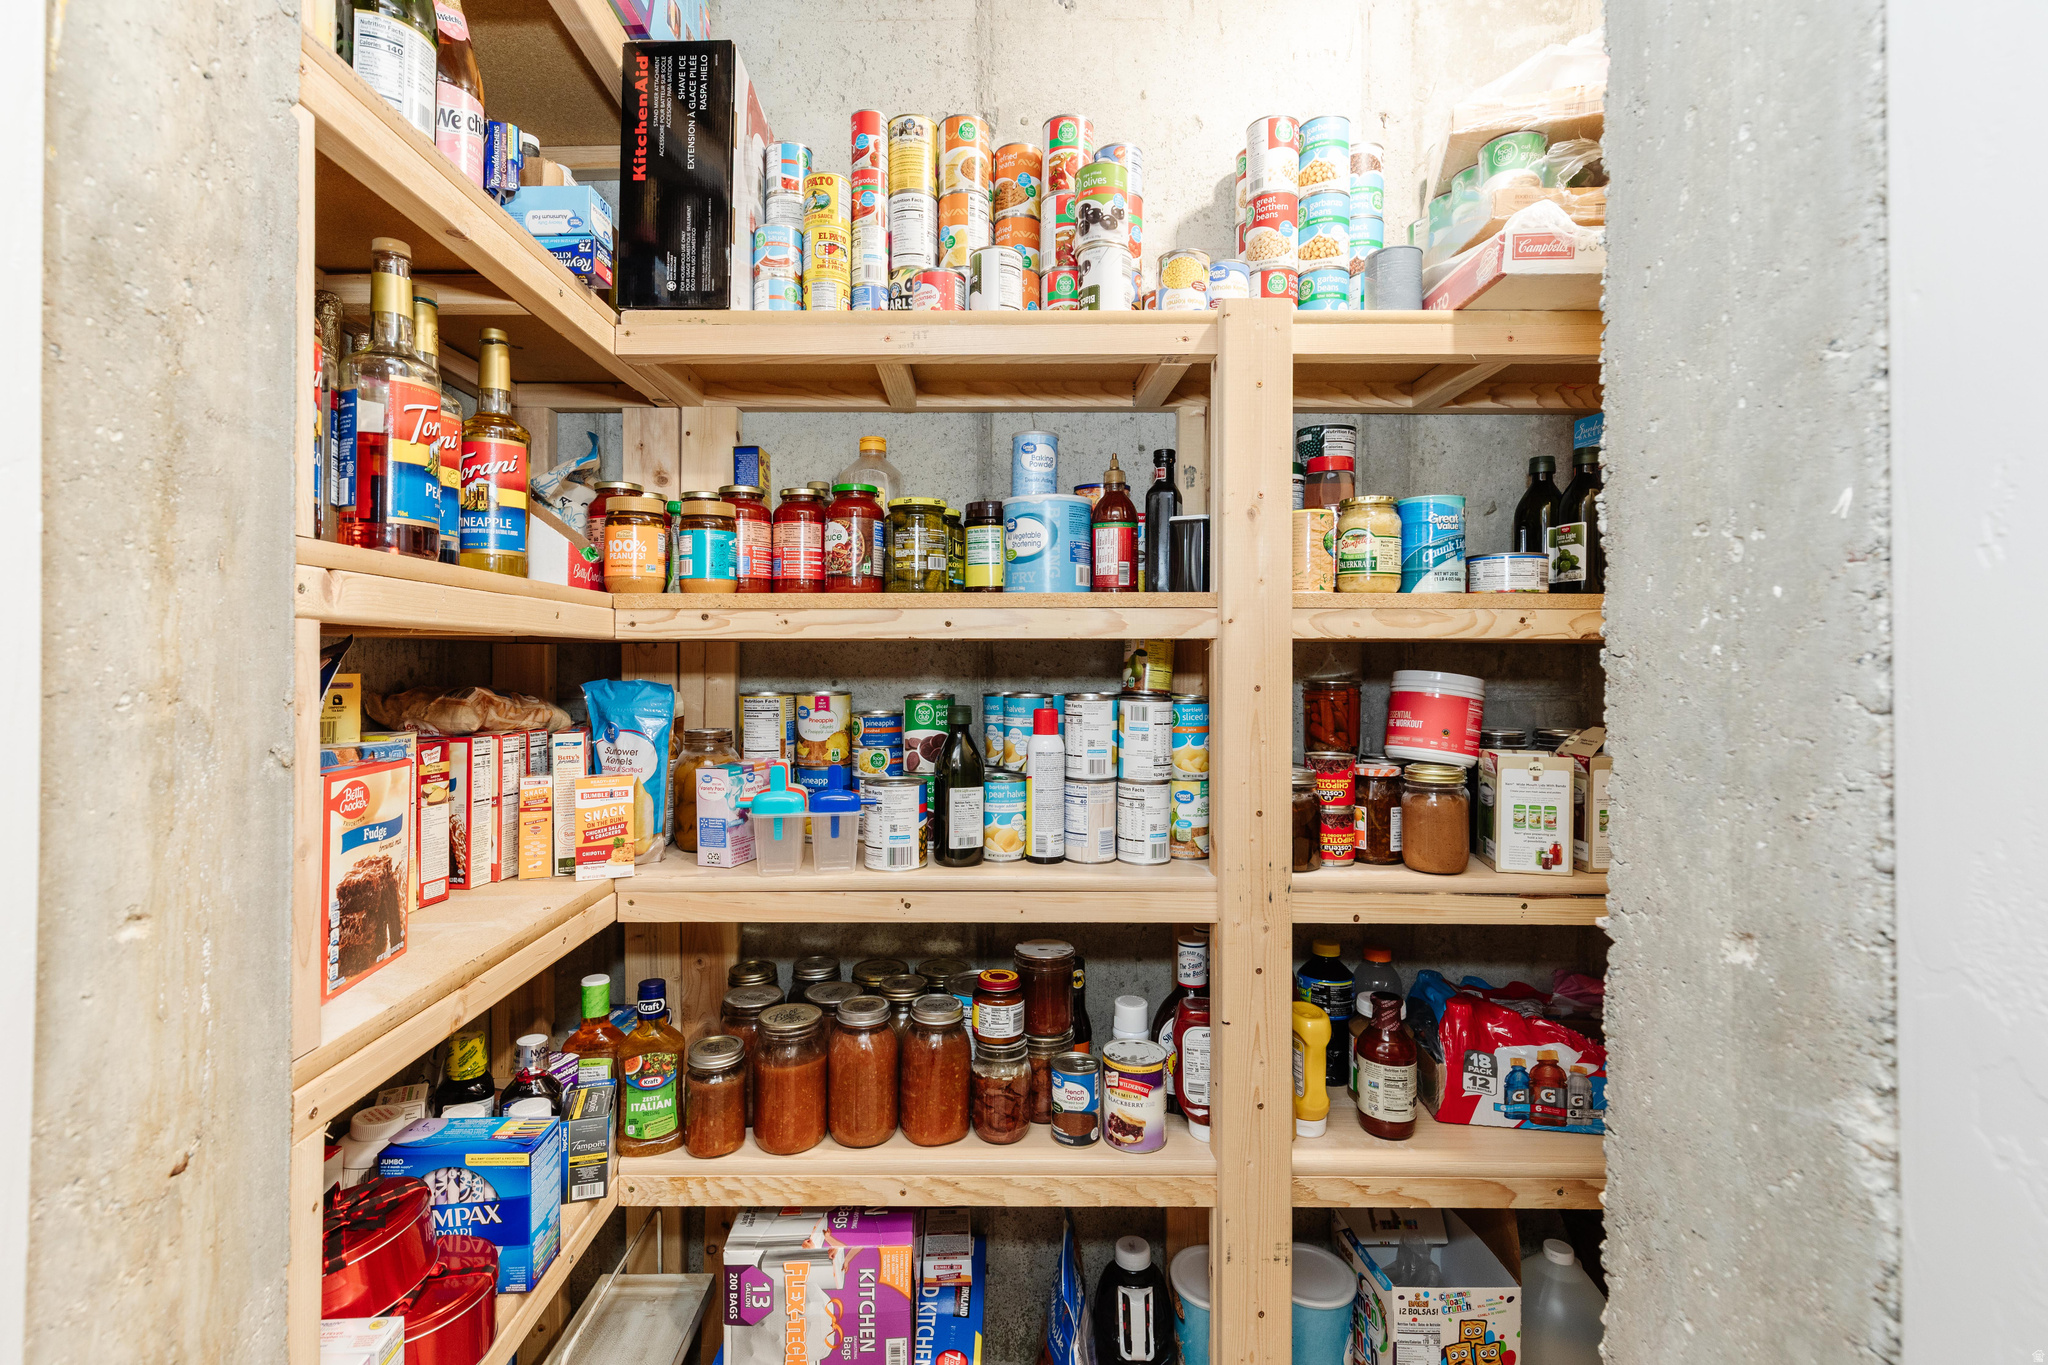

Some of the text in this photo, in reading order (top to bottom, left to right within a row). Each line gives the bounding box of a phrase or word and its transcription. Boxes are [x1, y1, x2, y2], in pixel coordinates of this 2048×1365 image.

[360, 40, 403, 56] Calories 140
[689, 55, 697, 78] PILÉE
[678, 71, 686, 99] SHAVE
[689, 80, 697, 109] GLACE
[633, 54, 648, 181] KitchenAid
[1498, 147, 1513, 157] food
[1498, 153, 1512, 161] club
[807, 176, 833, 188] PATO
[1083, 176, 1107, 188] olives
[1256, 196, 1277, 207] great
[1310, 199, 1343, 210] garbanzo
[1256, 203, 1289, 213] northern
[1310, 209, 1332, 218] beans
[1256, 212, 1278, 222] beans
[818, 232, 847, 244] EL PATO
[578, 243, 591, 252] 75
[1518, 239, 1570, 255] Campbell's
[1317, 275, 1348, 285] garbanzo
[1317, 284, 1339, 292] beans
[1031, 454, 1053, 463] Baking
[1428, 513, 1459, 523] Great
[1012, 531, 1041, 541] Vegetable
[609, 540, 646, 552] 100%
[1012, 540, 1041, 548] Shortening
[573, 563, 588, 583] Betty
[1012, 571, 1036, 583] FRY
[1007, 705, 1025, 713] halves
[1182, 712, 1204, 721] sliced
[1390, 711, 1412, 719] ESSENTIAL
[1388, 719, 1424, 728] PRE-WORKOUT
[343, 786, 364, 801] Betty
[524, 789, 547, 797] SNACK
[988, 790, 1026, 799] pear halves
[340, 799, 368, 814] Crocker
[584, 805, 626, 822] SNACK
[363, 826, 387, 841] Fudge
[586, 824, 625, 837] CHICKEN SALAD
[594, 830, 621, 839] CRACKERS
[1188, 961, 1203, 969] Sauce
[640, 1002, 659, 1011] Kraft
[1470, 1053, 1491, 1068] 18
[1468, 1066, 1492, 1075] PACK
[1120, 1082, 1149, 1094] WILDERNESS
[1468, 1076, 1490, 1089] 12
[1112, 1089, 1139, 1099] PREMIUM
[1512, 1091, 1525, 1102] G
[1540, 1089, 1556, 1103] G
[631, 1098, 672, 1112] ITALIAN
[1108, 1096, 1144, 1108] BLACKBERRY
[1571, 1095, 1584, 1106] G
[571, 1139, 606, 1152] Tampons
[380, 1158, 404, 1166] JUMBO
[729, 1273, 738, 1320] 200 BAGS
[752, 1282, 770, 1308] 13
[1439, 1291, 1471, 1300] Cinnamon
[1408, 1300, 1429, 1308] BAGS!
[1446, 1297, 1465, 1306] Toast
[859, 1268, 876, 1353] KITCHEN
[1442, 1303, 1472, 1314] Crunch
[842, 1336, 853, 1361] Bags
